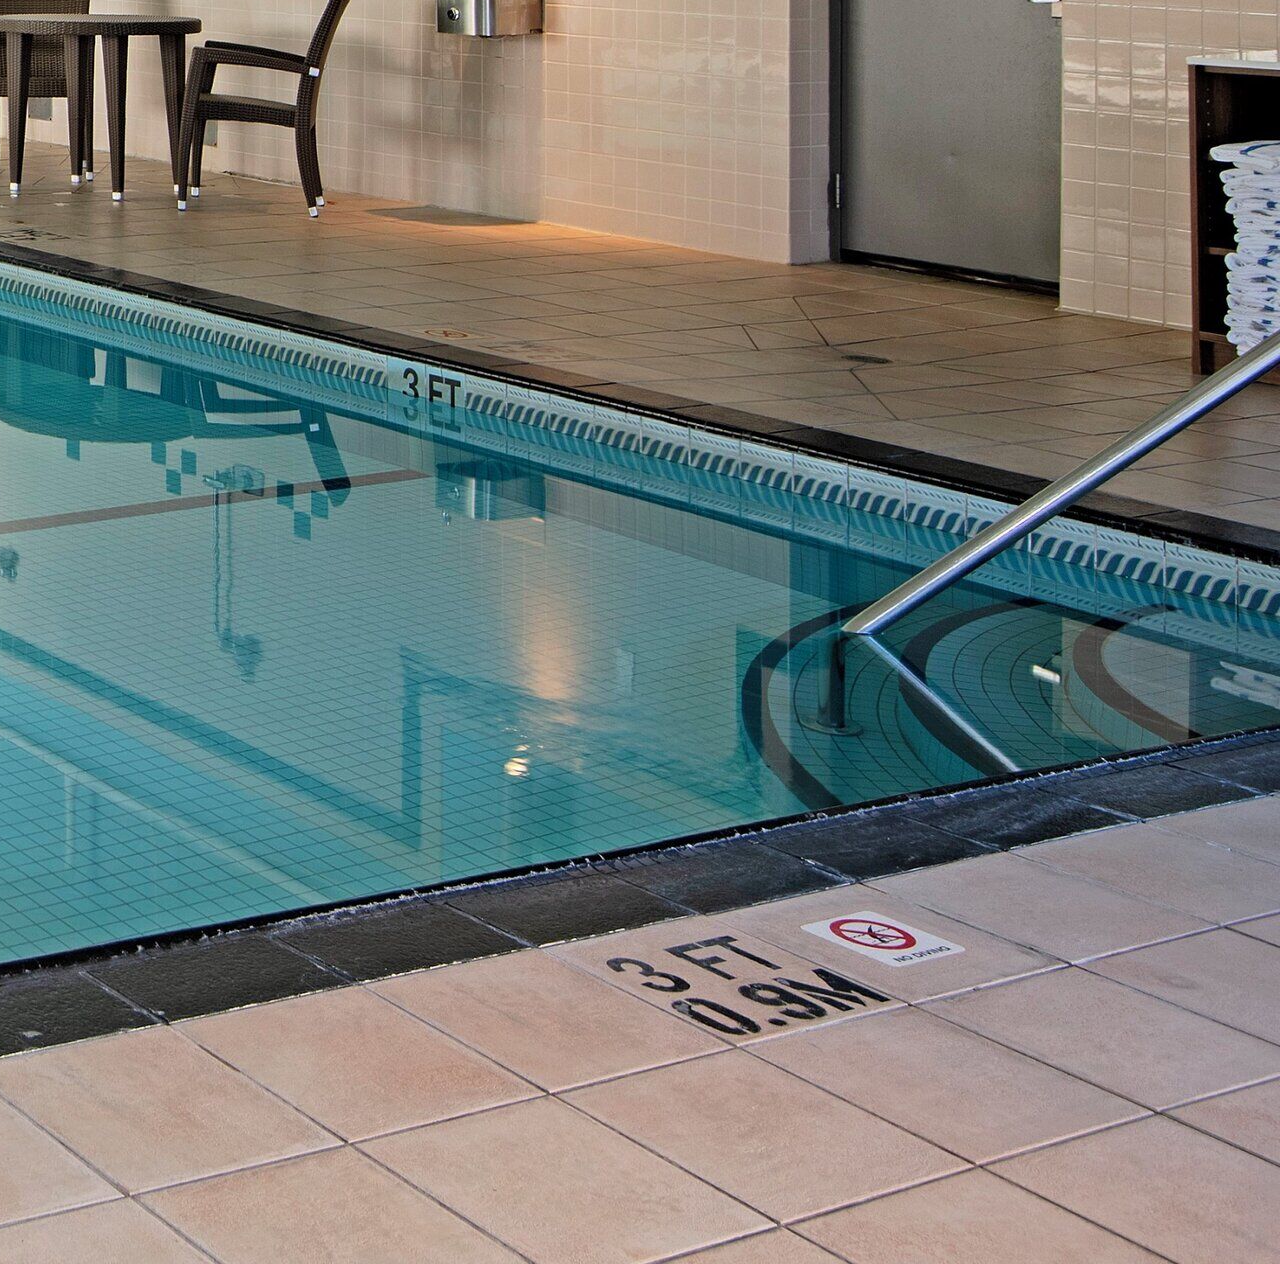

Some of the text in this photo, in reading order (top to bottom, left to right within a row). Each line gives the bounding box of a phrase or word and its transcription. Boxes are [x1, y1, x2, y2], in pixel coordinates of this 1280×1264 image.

[402, 367, 461, 408] 3 FT
[605, 935, 782, 993] 3 FT
[892, 945, 952, 963] NO DIVING
[671, 968, 892, 1036] 0.9M
